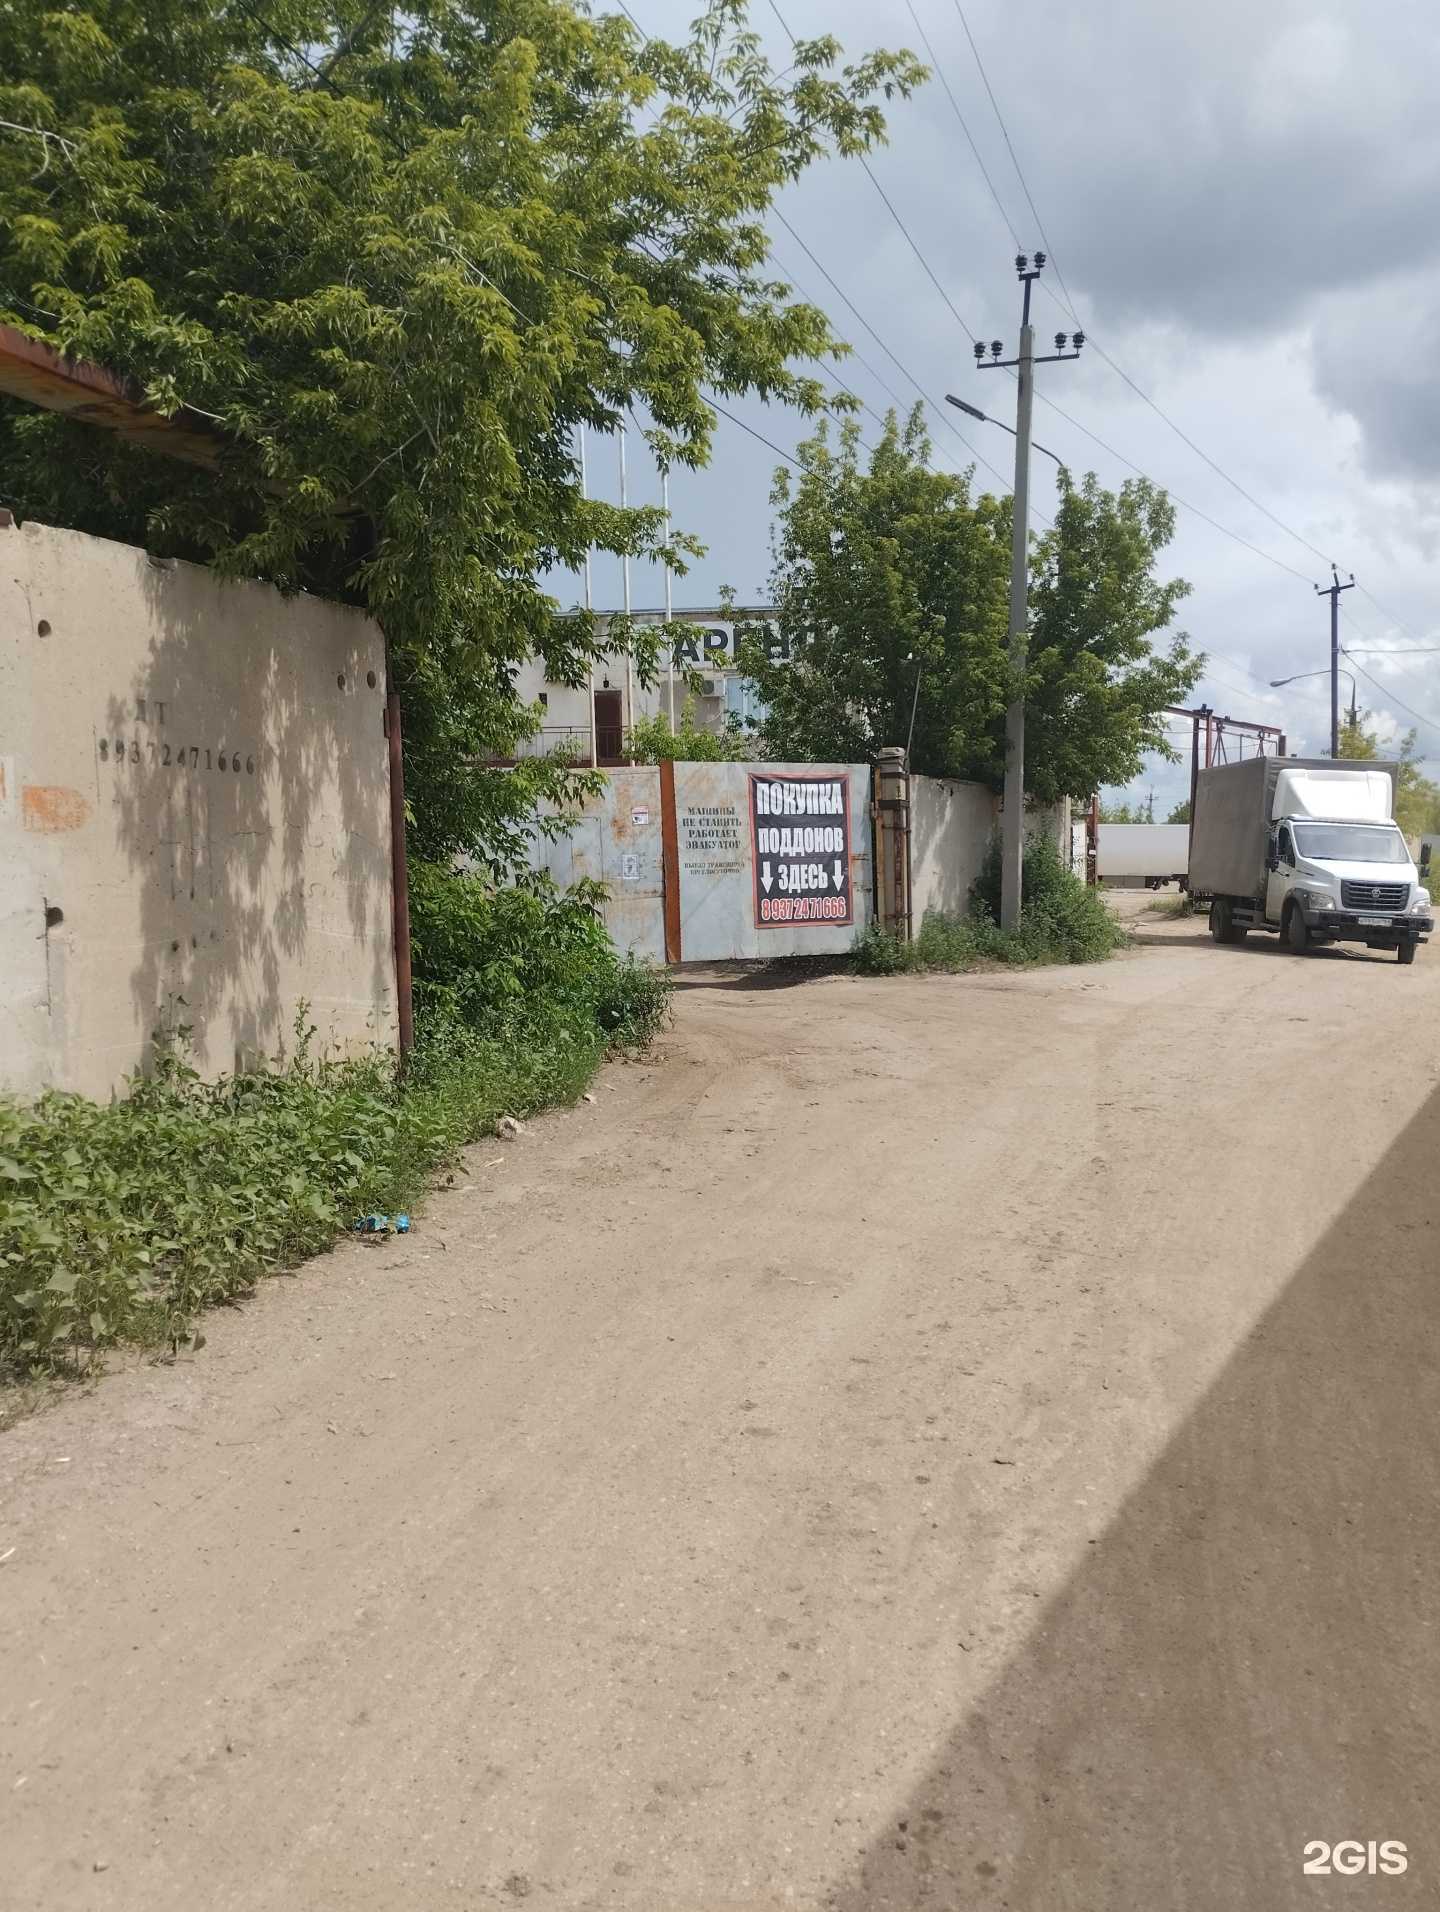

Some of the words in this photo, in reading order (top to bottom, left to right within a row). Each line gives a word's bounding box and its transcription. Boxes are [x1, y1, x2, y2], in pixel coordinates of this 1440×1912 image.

[756, 782, 844, 816] ПОКУПКА
[687, 807, 736, 816] МАШИНЫ
[682, 818, 696, 827] НЕ
[698, 818, 742, 827] СТАВИТЬ
[688, 829, 738, 838] РАБОТАЕТ
[685, 840, 741, 850] ЭВАКУАТОР
[758, 827, 844, 857] ПОДДОНОВ
[777, 863, 829, 893] ЗДЕСЬ
